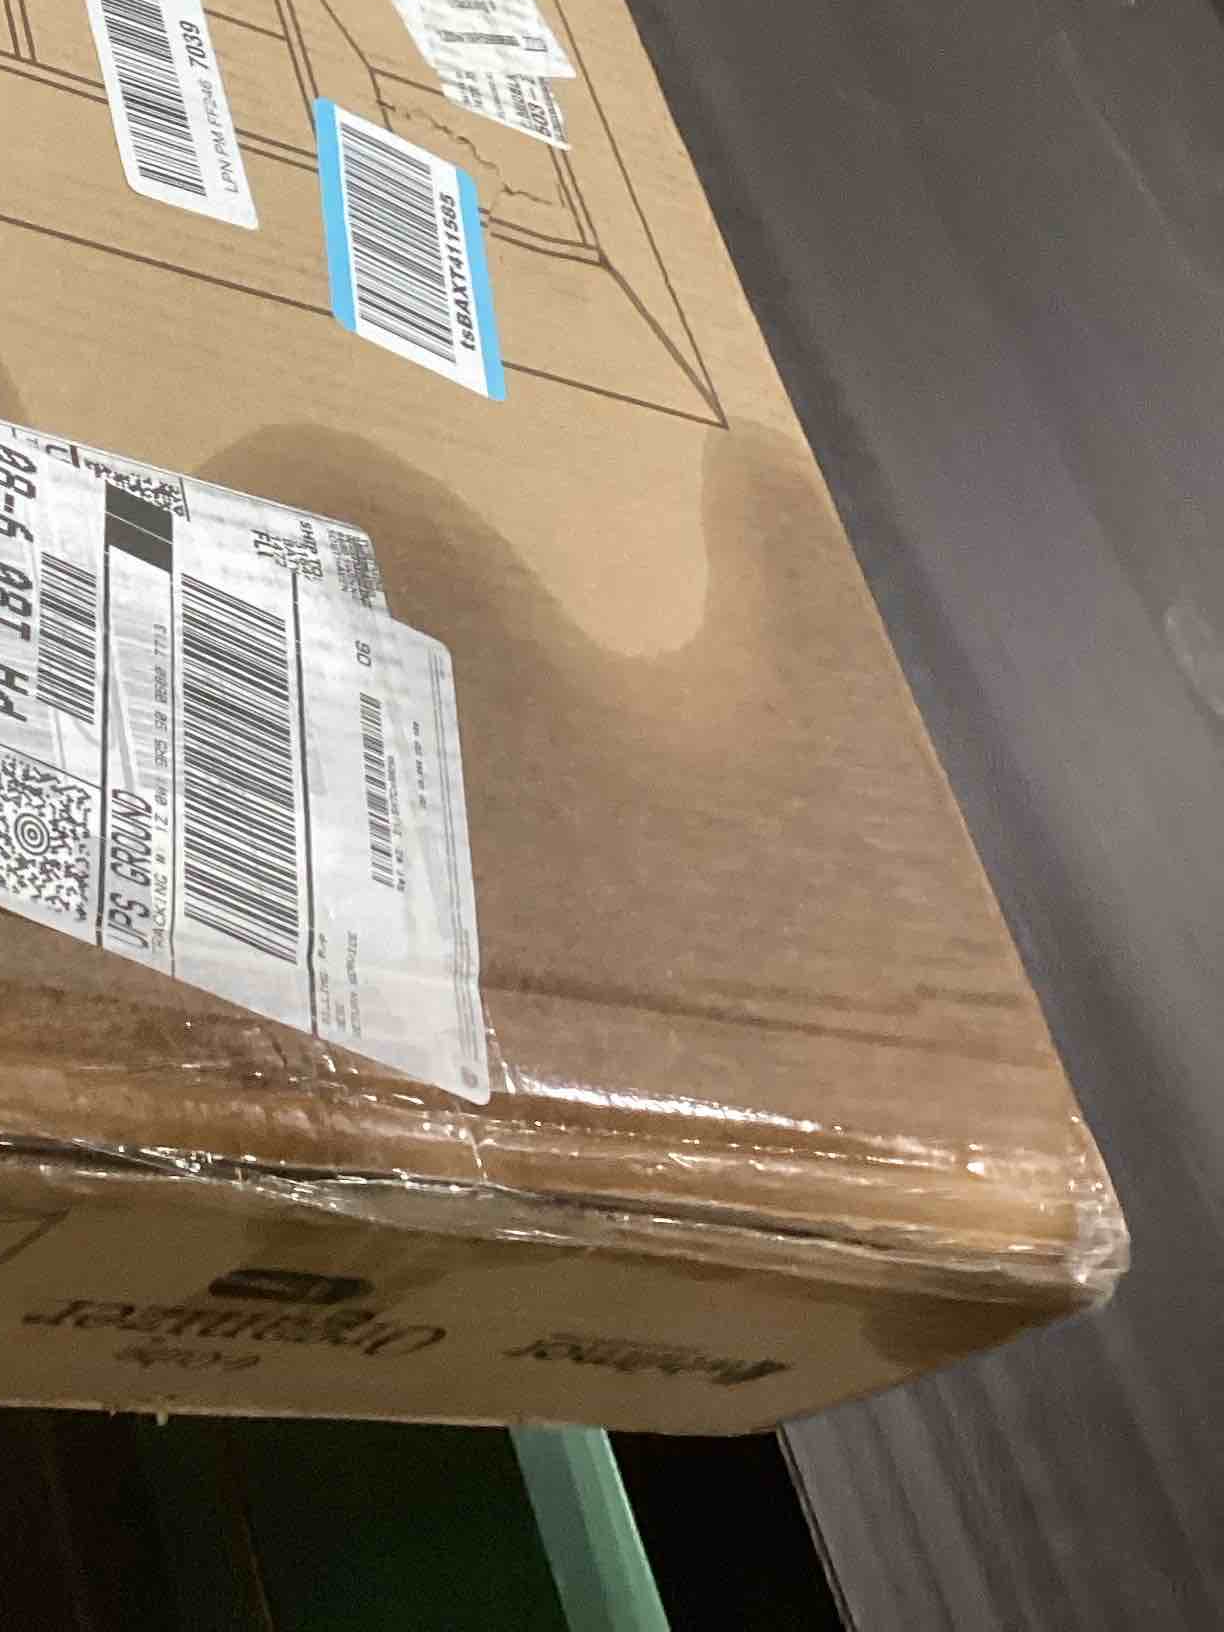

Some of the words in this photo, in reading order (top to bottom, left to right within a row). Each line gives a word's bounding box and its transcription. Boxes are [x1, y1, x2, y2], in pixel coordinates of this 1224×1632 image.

[178, 19, 210, 71] 7039
[298, 519, 319, 555] SHIP
[354, 639, 373, 667] 06
[109, 787, 153, 888] GROUND
[107, 891, 150, 950] UPS
